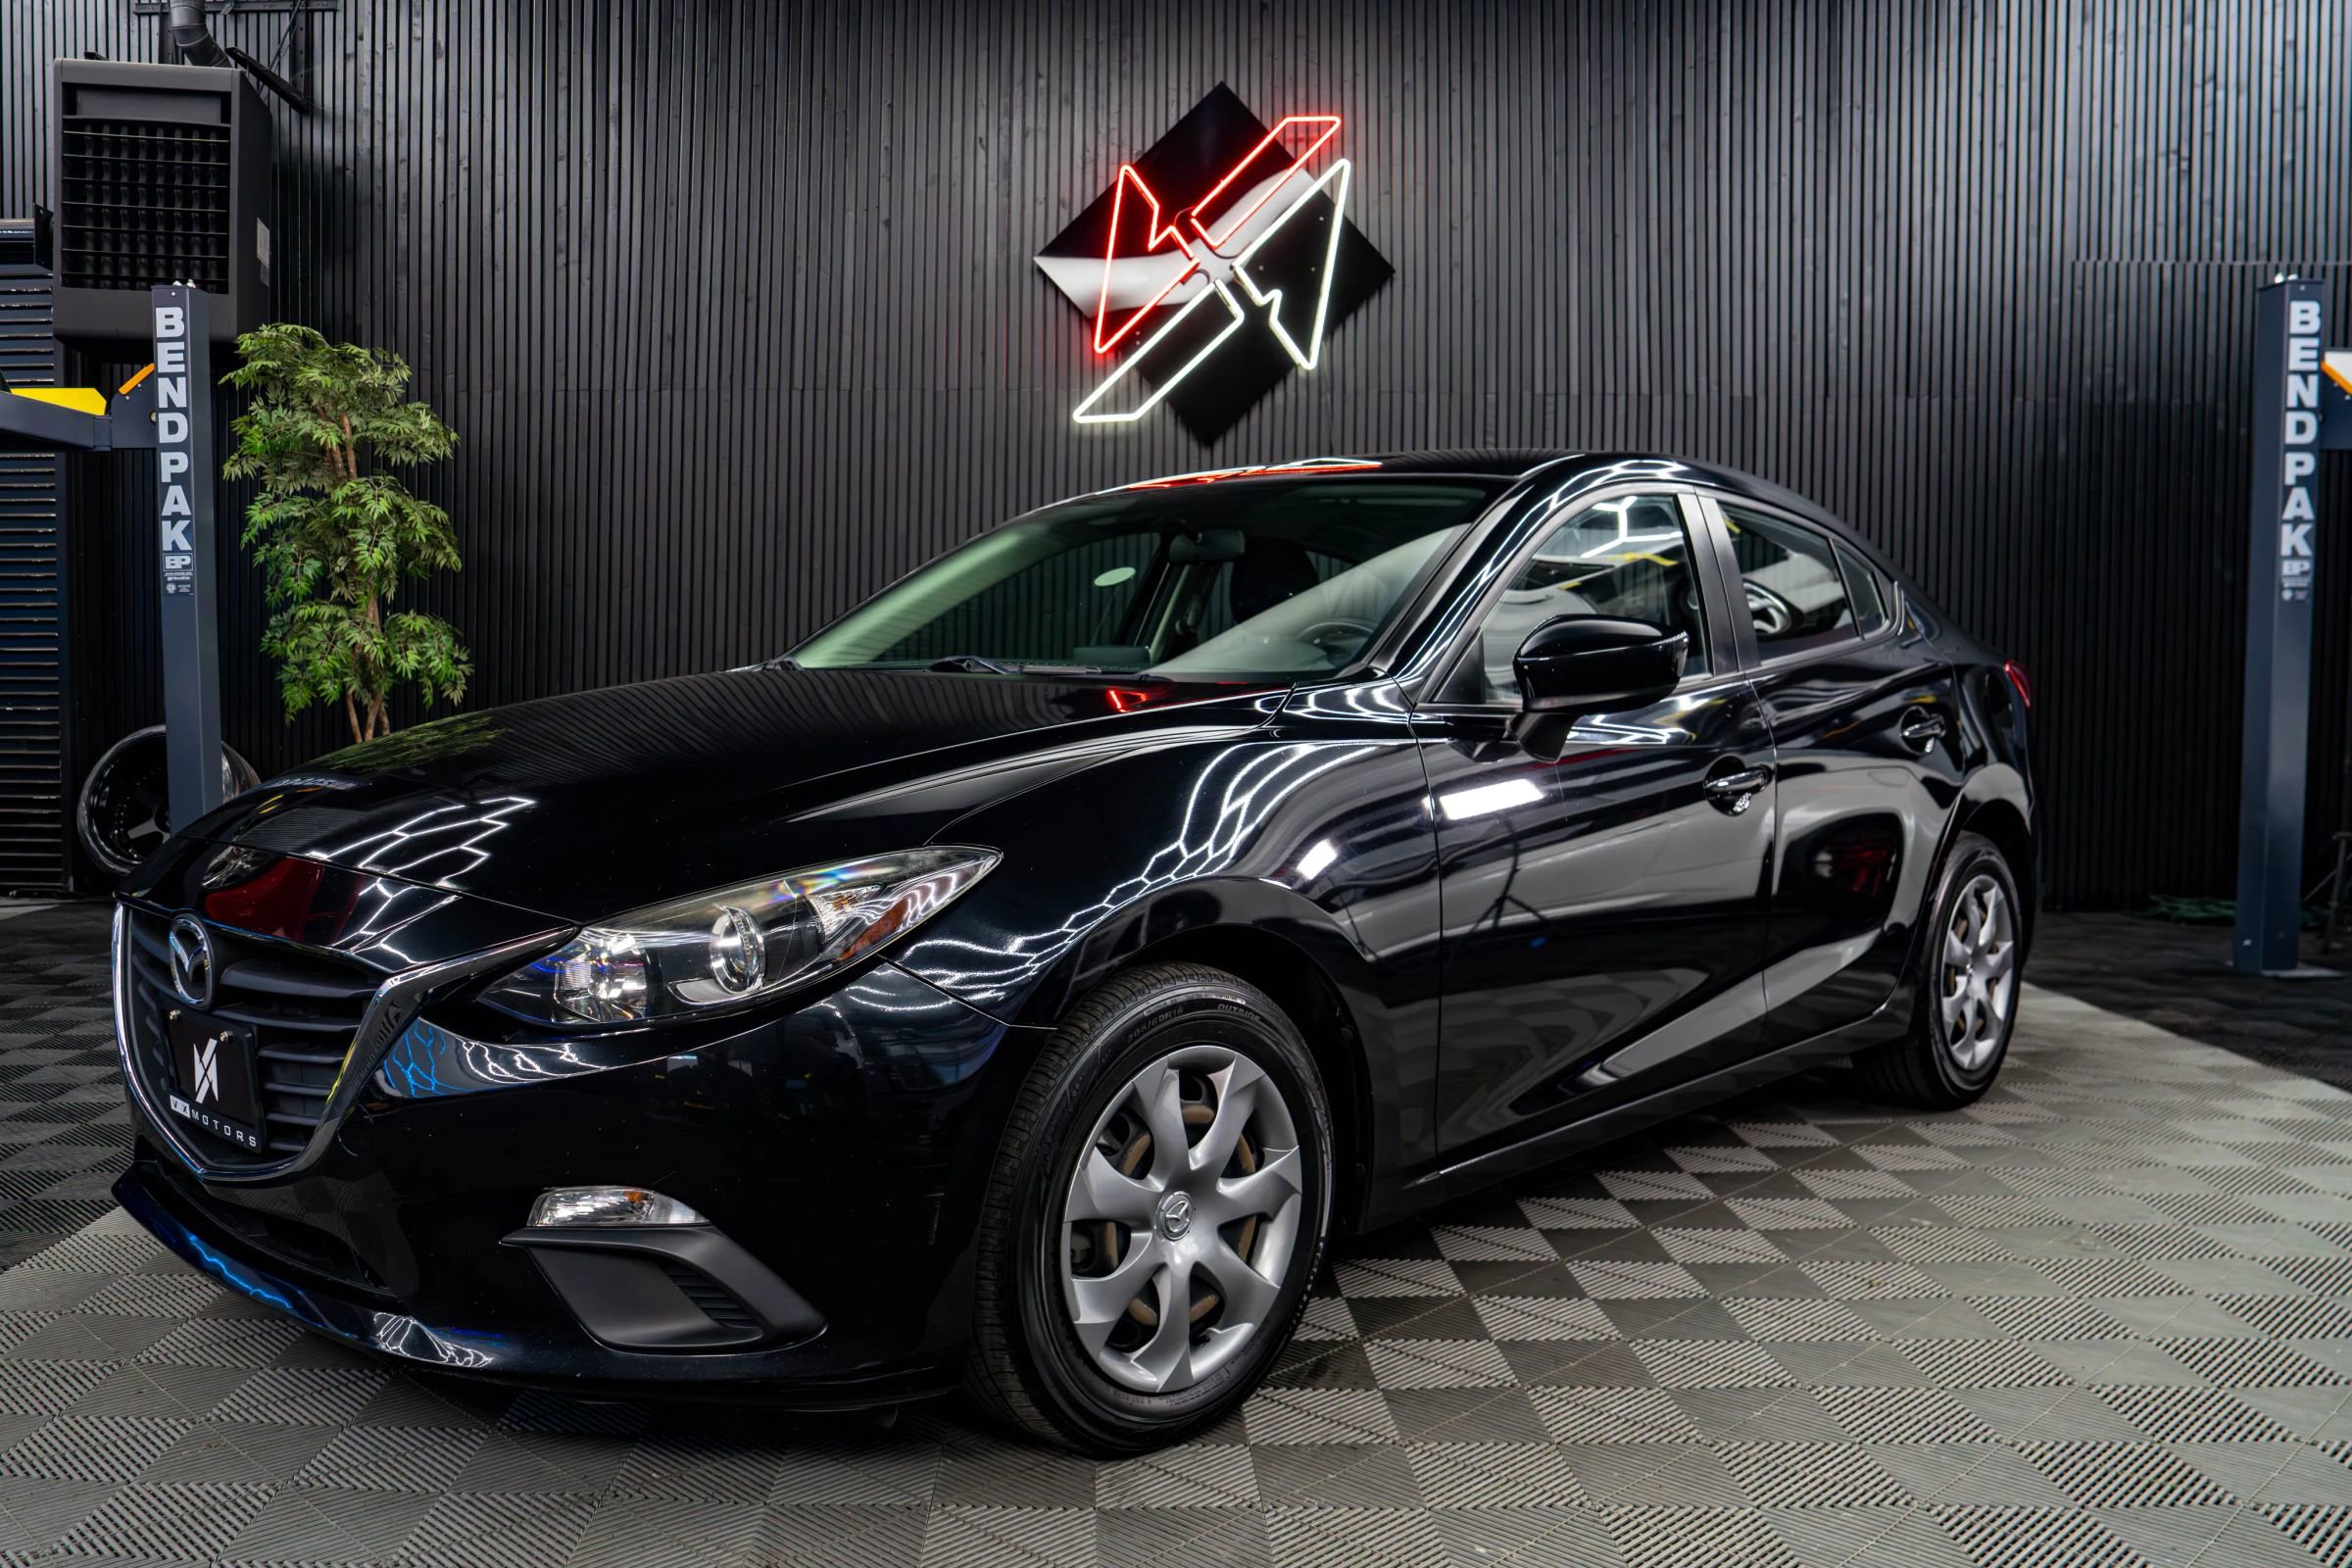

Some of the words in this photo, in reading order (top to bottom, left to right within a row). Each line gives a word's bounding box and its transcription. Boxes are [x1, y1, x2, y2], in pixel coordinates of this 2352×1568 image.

[155, 307, 193, 552] BENDPAK
[2280, 300, 2321, 557] BENDPAK
[166, 555, 191, 568] BP
[191, 1108, 257, 1147] MOTORS
